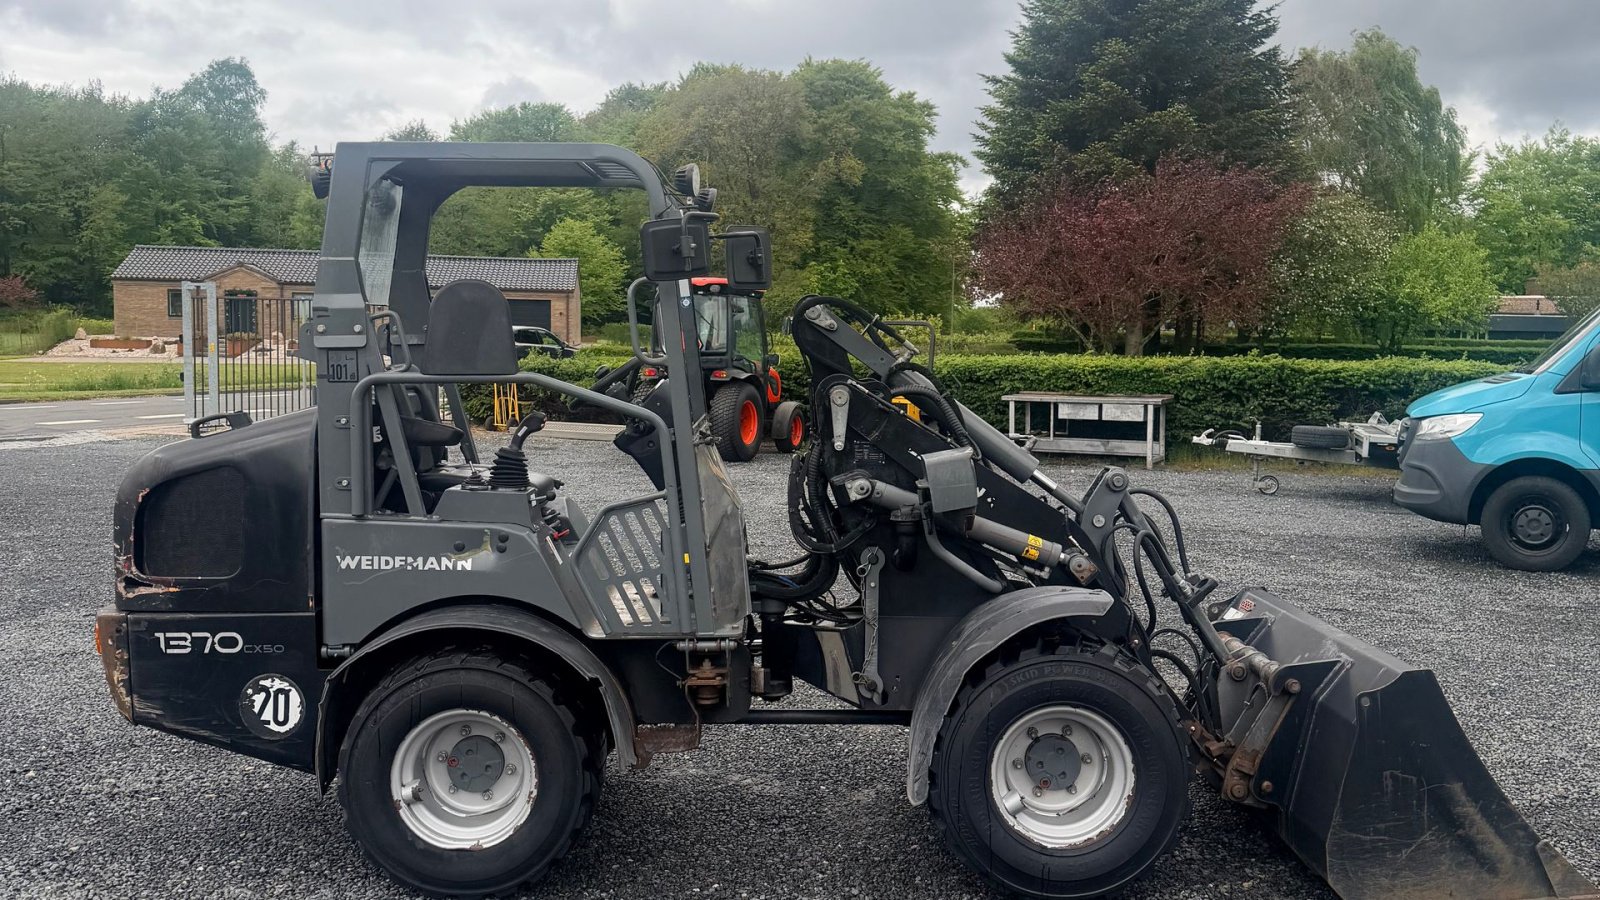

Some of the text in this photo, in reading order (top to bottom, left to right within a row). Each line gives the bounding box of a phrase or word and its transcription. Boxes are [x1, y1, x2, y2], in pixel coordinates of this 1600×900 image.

[330, 363, 348, 380] 101
[335, 555, 472, 571] WEIDEMANN
[154, 631, 285, 654] 1370 CX50
[254, 687, 291, 727] 20
